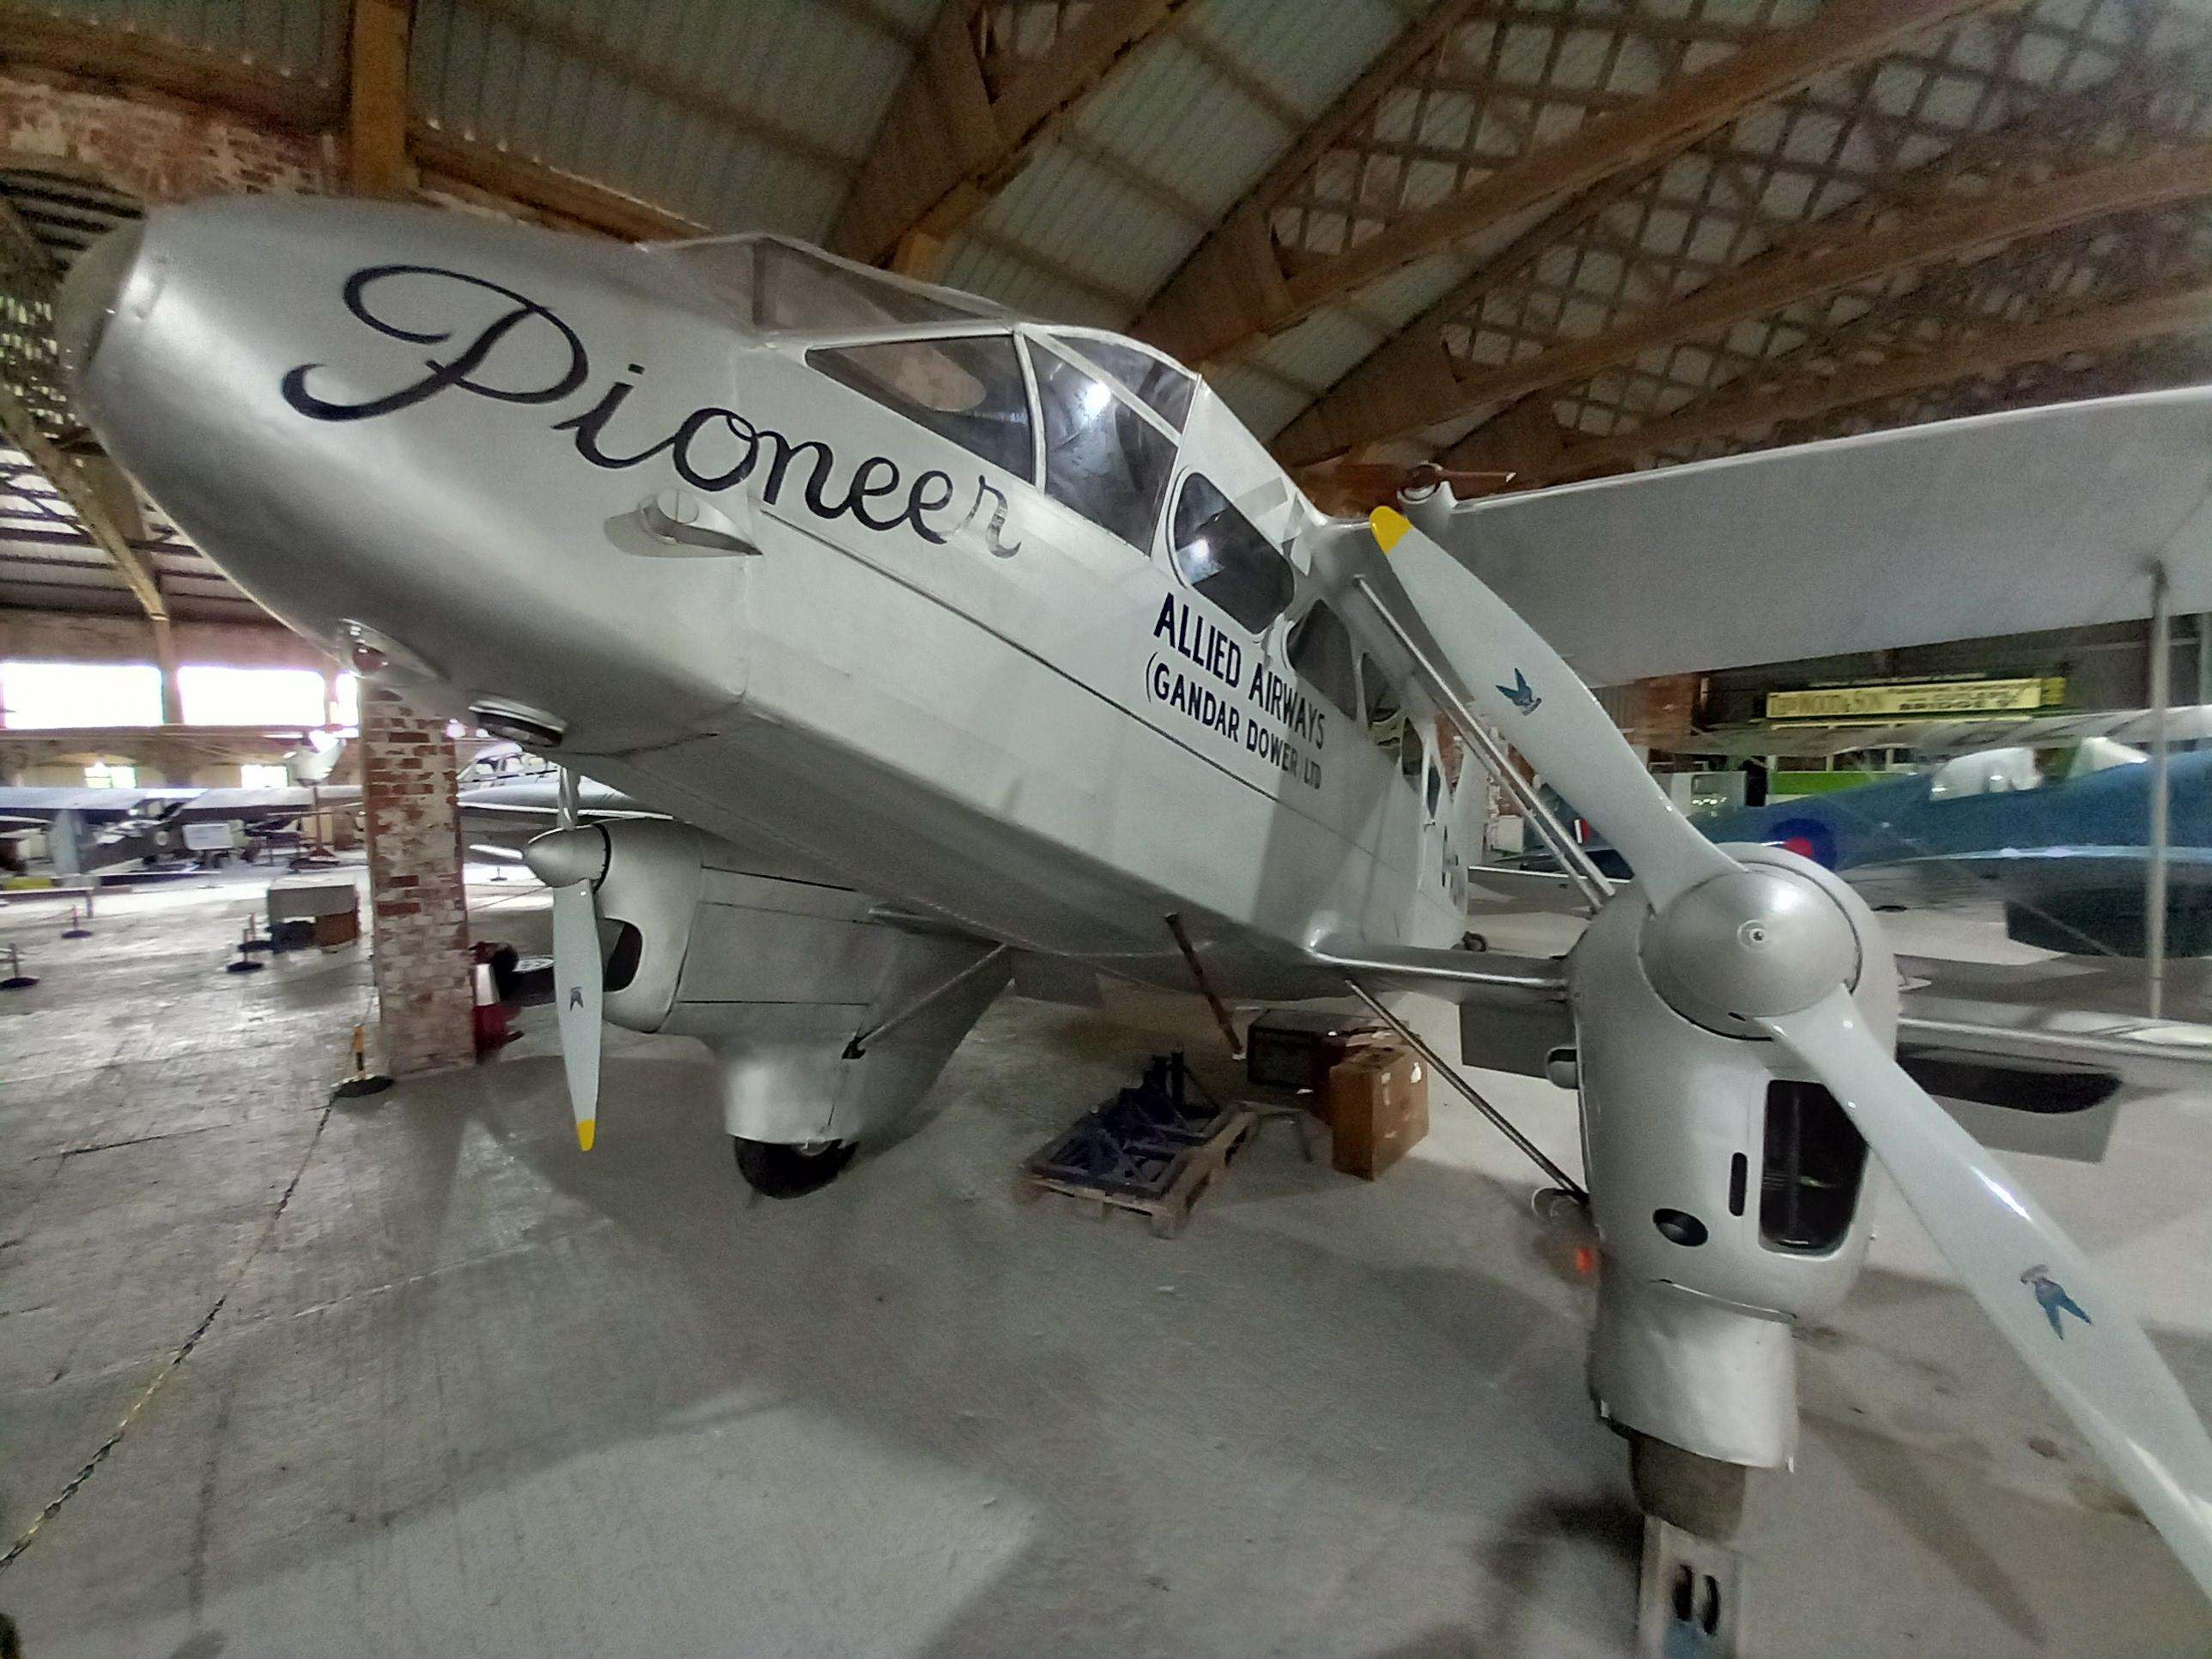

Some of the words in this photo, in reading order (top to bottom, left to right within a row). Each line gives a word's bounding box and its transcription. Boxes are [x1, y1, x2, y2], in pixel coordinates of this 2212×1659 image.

[282, 264, 1022, 559] Pioneer
[1146, 651, 1240, 744] (GANDAR
[1153, 592, 1242, 689] ALLIED
[1248, 662, 1326, 750] AIRWAYS
